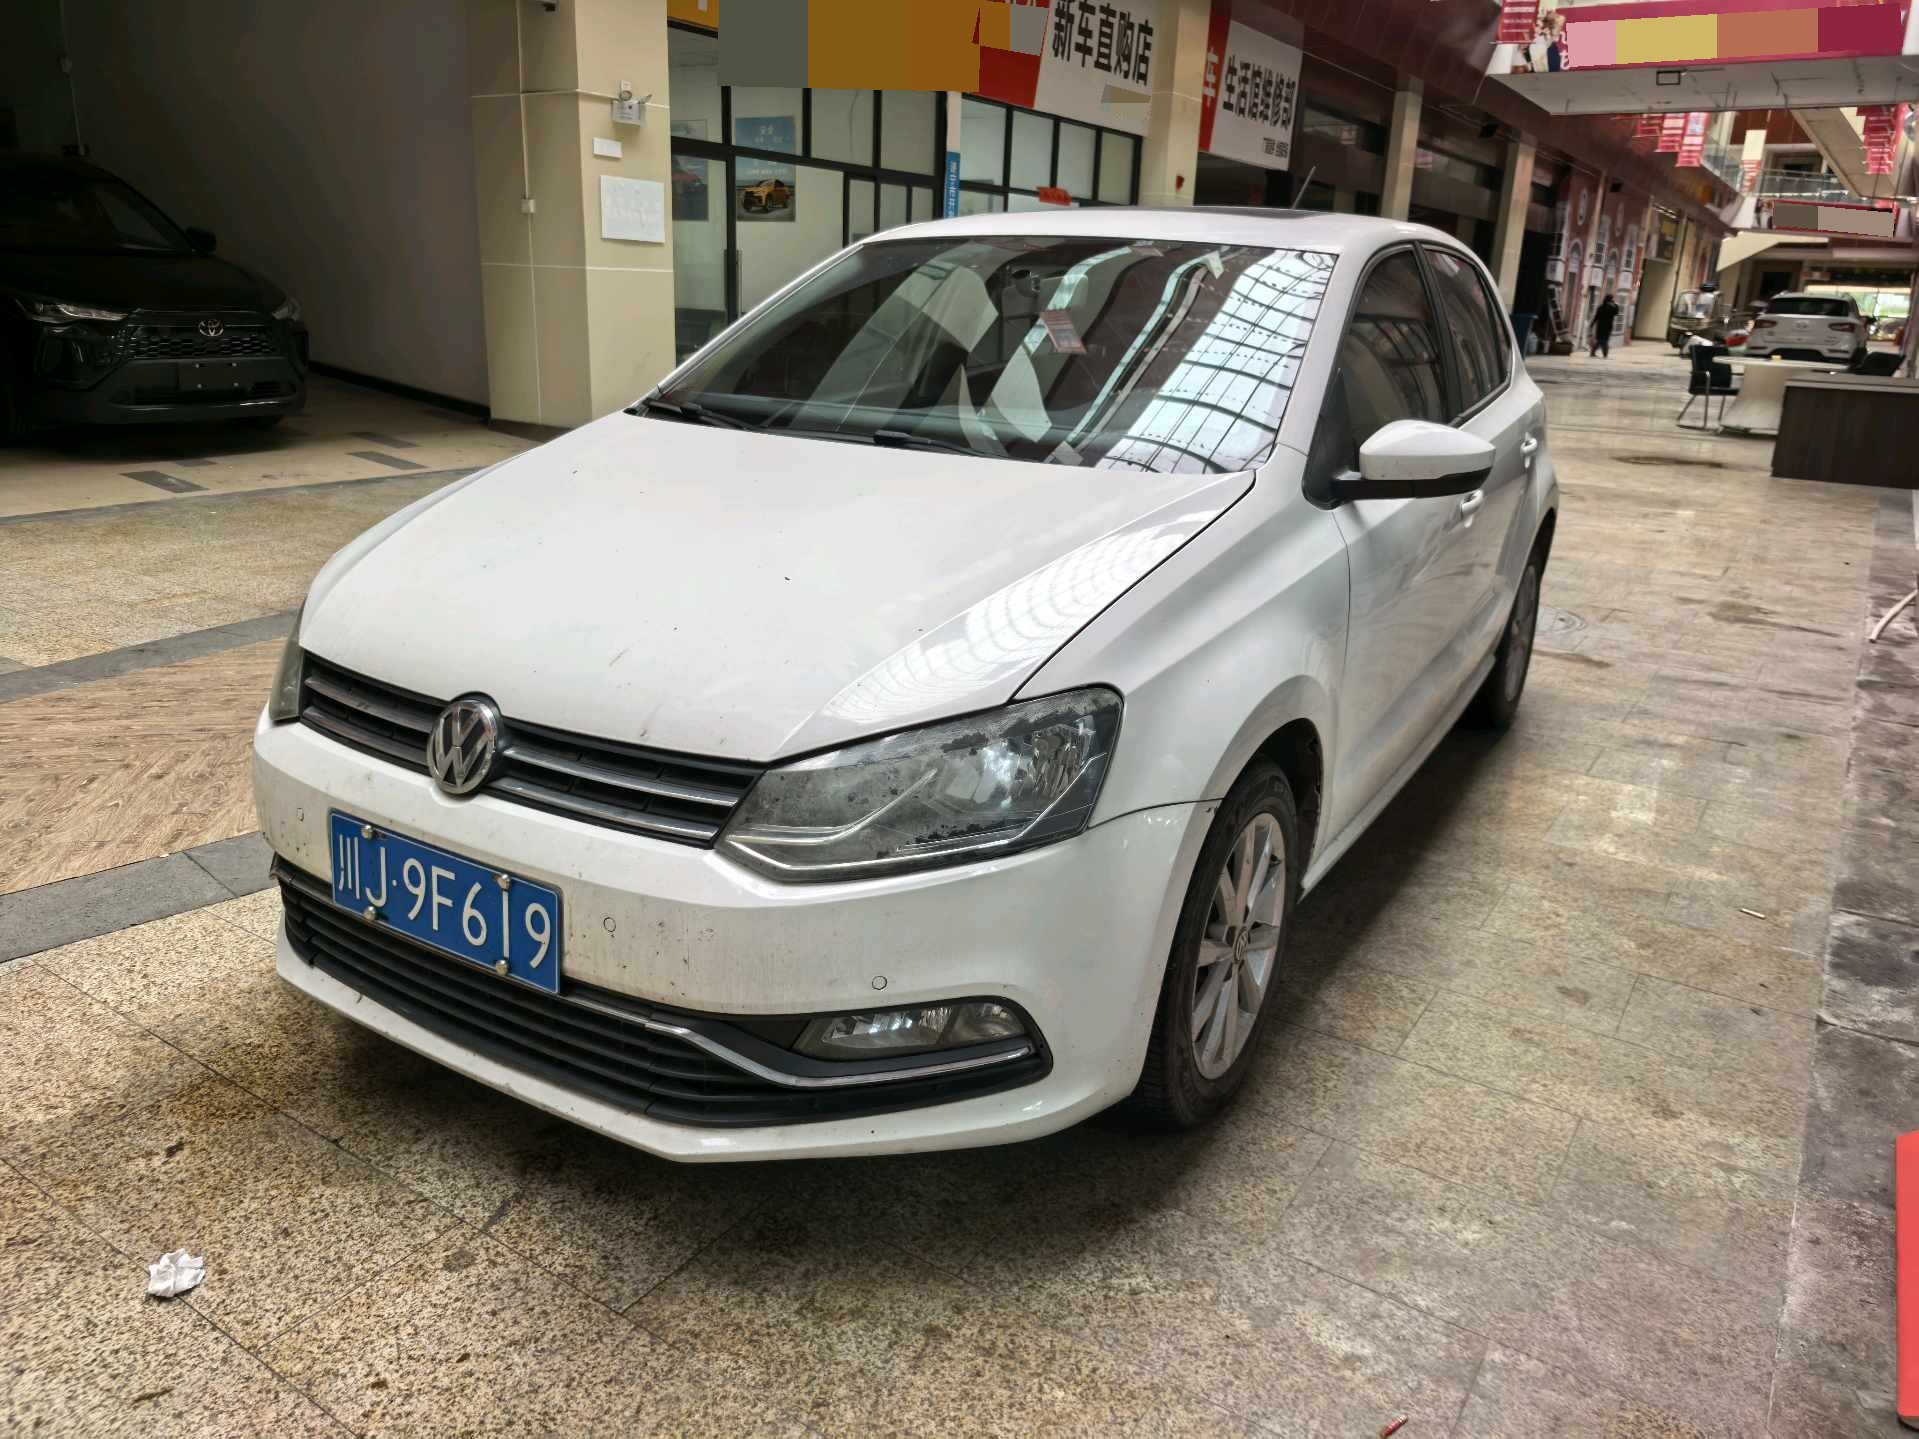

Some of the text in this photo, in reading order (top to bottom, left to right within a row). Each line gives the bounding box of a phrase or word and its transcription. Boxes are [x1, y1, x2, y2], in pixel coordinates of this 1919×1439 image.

[1052, 0, 1154, 86] 新车直购店
